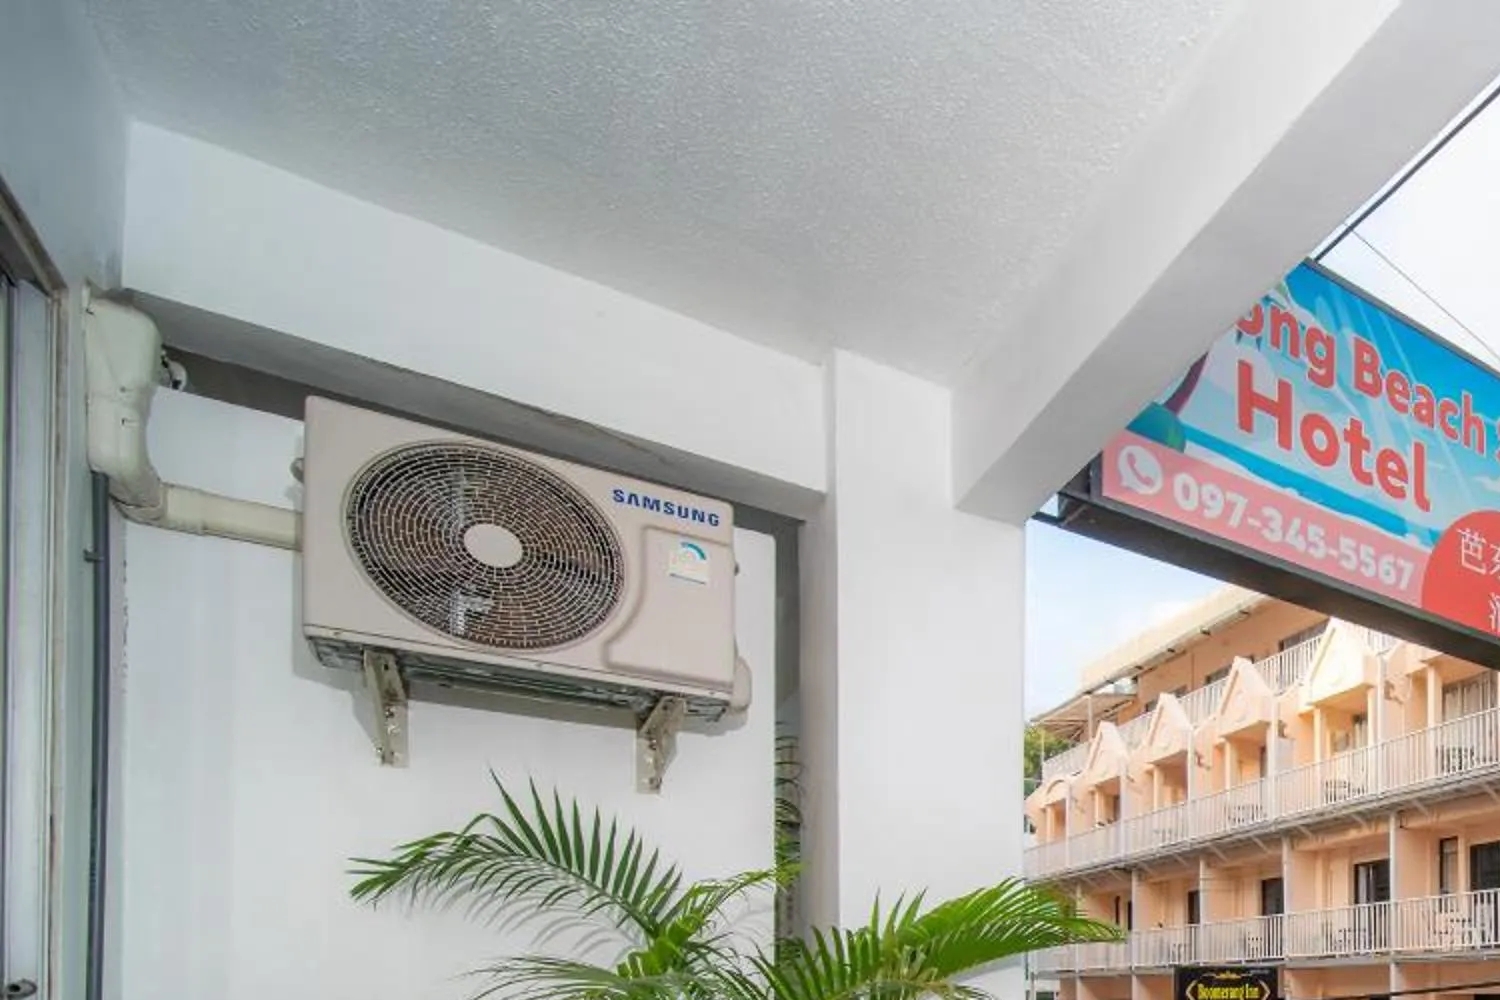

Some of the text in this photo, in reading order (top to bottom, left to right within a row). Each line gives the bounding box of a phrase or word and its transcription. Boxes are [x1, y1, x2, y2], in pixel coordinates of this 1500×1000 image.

[1236, 359, 1431, 513] Hotel
[1353, 335, 1486, 455] Beach
[612, 488, 721, 527] SAMSUNG
[1172, 471, 1414, 592] 097-345-5567
